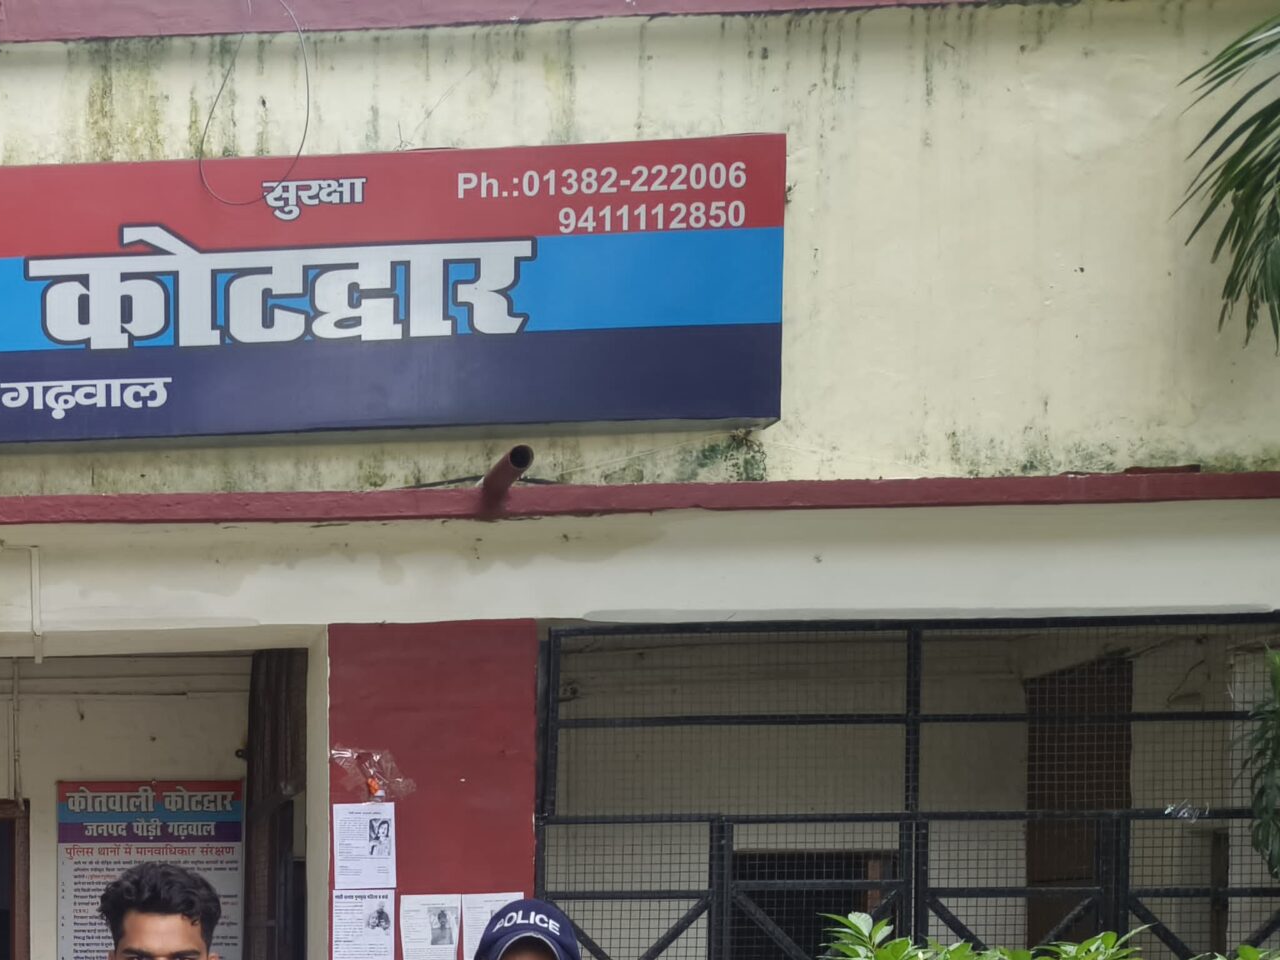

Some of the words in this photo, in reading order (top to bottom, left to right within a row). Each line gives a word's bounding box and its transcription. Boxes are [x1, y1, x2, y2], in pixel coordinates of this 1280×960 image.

[457, 161, 747, 199] Ph.:01382-222006
[261, 177, 367, 221] सुरक्षा
[558, 200, 746, 234] 9411112850
[27, 225, 533, 350] कोटद्वार
[0, 376, 173, 420] गढ़वाल
[65, 786, 156, 812] कोतवाली
[162, 786, 234, 812] कोटद्वार
[83, 822, 128, 837] जनपद
[132, 818, 163, 840] पौड़ी
[167, 821, 216, 840] गढ़वाल
[65, 845, 94, 860] पुलिस
[123, 844, 132, 856] में
[136, 844, 197, 857] मानवाधिकार
[199, 844, 235, 857] संरक्षण
[492, 910, 561, 936] POLICE
